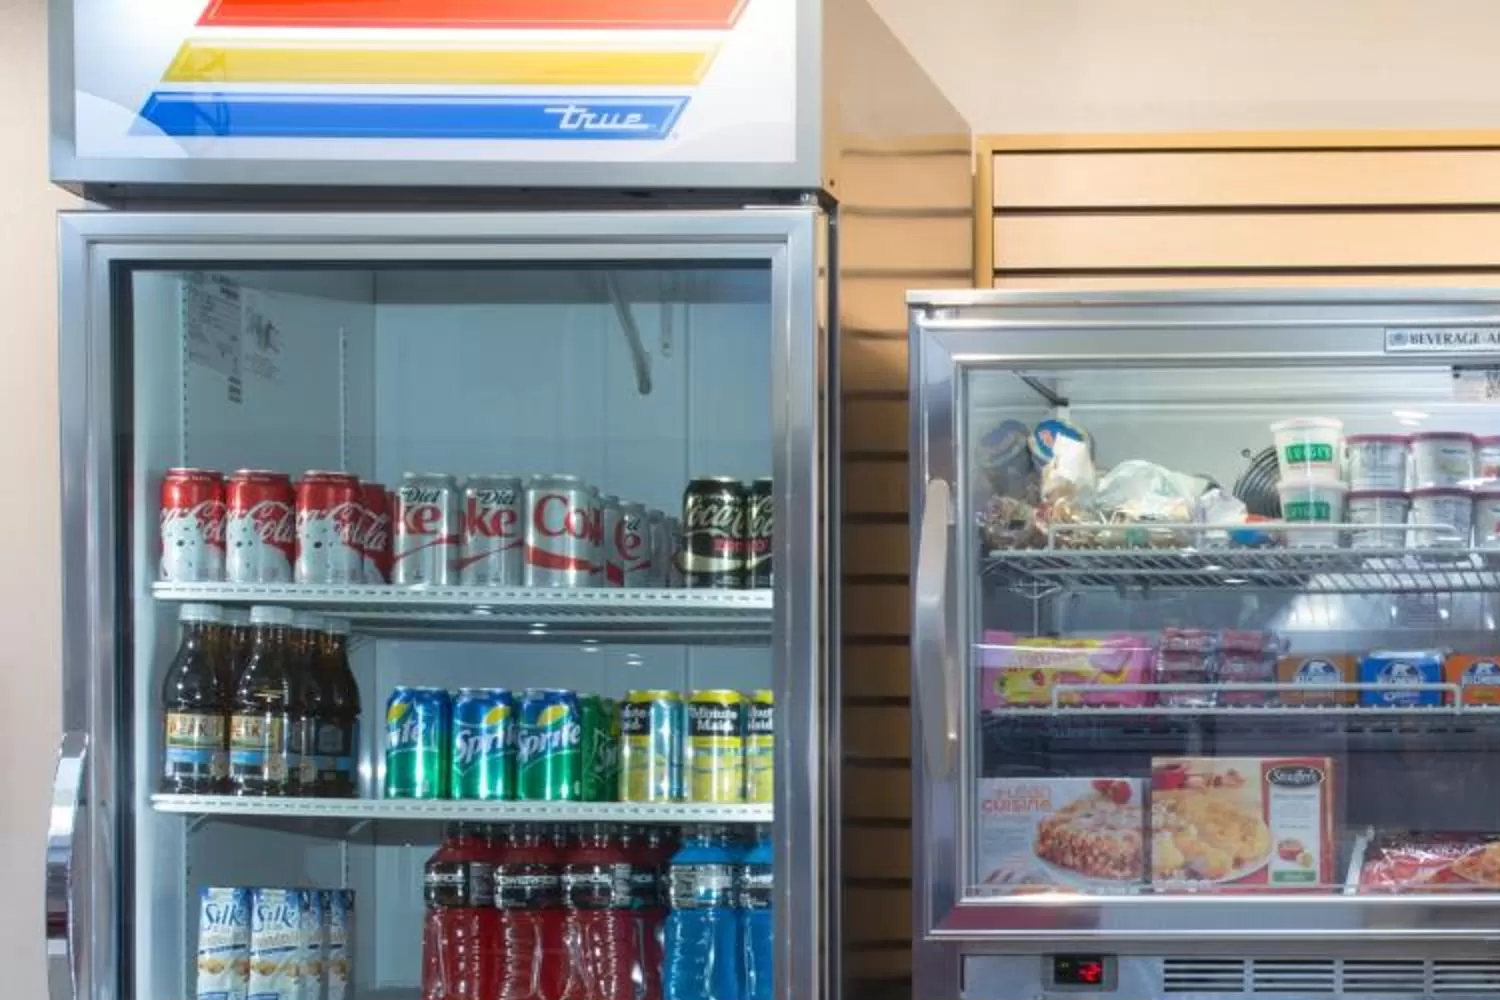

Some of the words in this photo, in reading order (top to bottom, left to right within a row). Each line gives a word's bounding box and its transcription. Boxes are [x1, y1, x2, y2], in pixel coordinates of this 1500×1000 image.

[401, 501, 442, 535] ke
[465, 496, 518, 538] ke
[515, 721, 581, 763] Sprite
[205, 903, 247, 932] Silk
[257, 904, 301, 932] Silk
